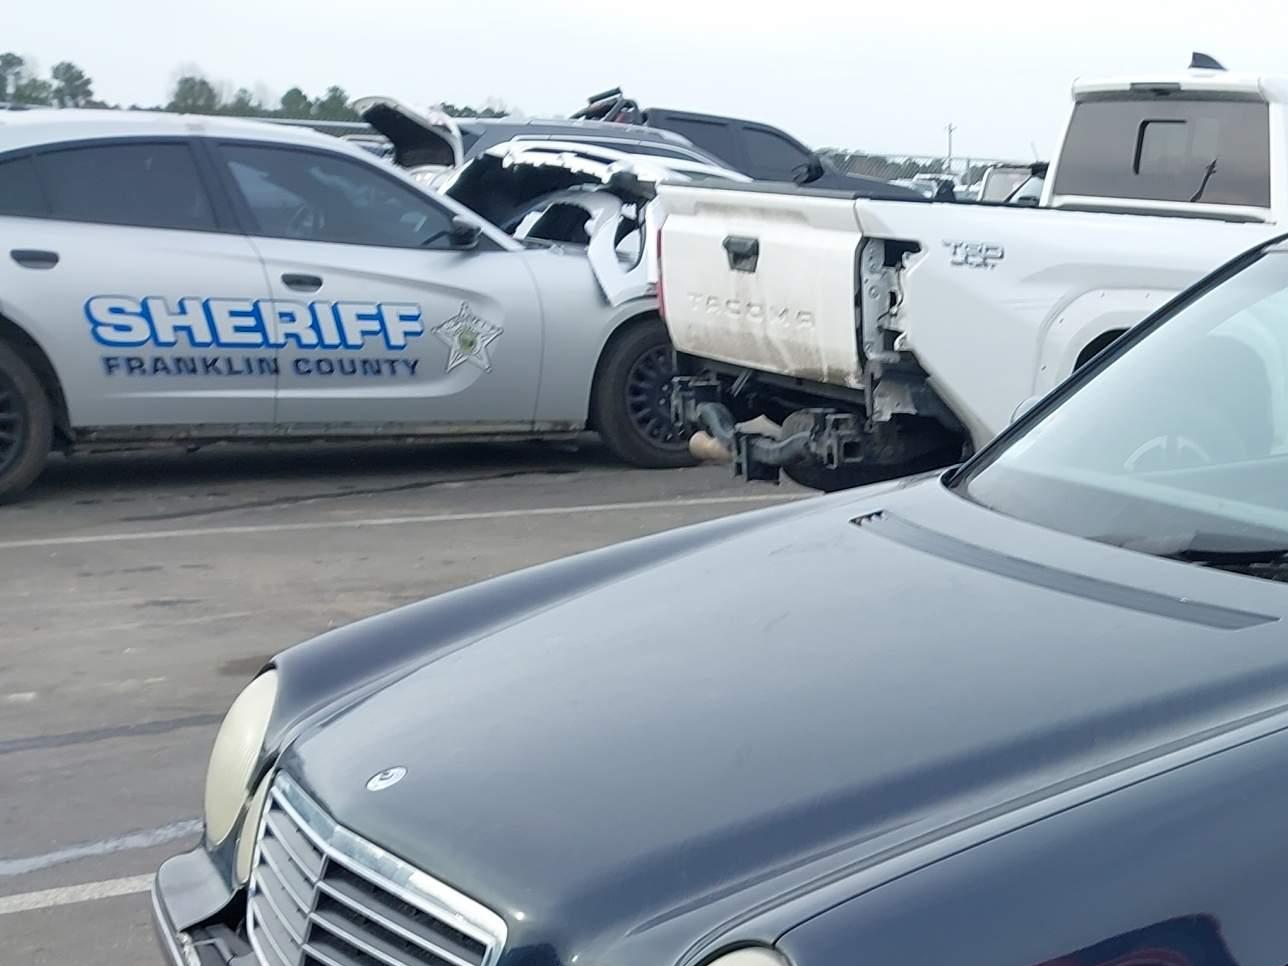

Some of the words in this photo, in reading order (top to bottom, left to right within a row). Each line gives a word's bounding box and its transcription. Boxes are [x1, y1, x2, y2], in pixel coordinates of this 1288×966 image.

[84, 295, 424, 350] SHERIFF
[687, 291, 815, 333] TACOMA
[102, 356, 280, 376] FRANKLIN
[293, 358, 419, 376] COUNTY
